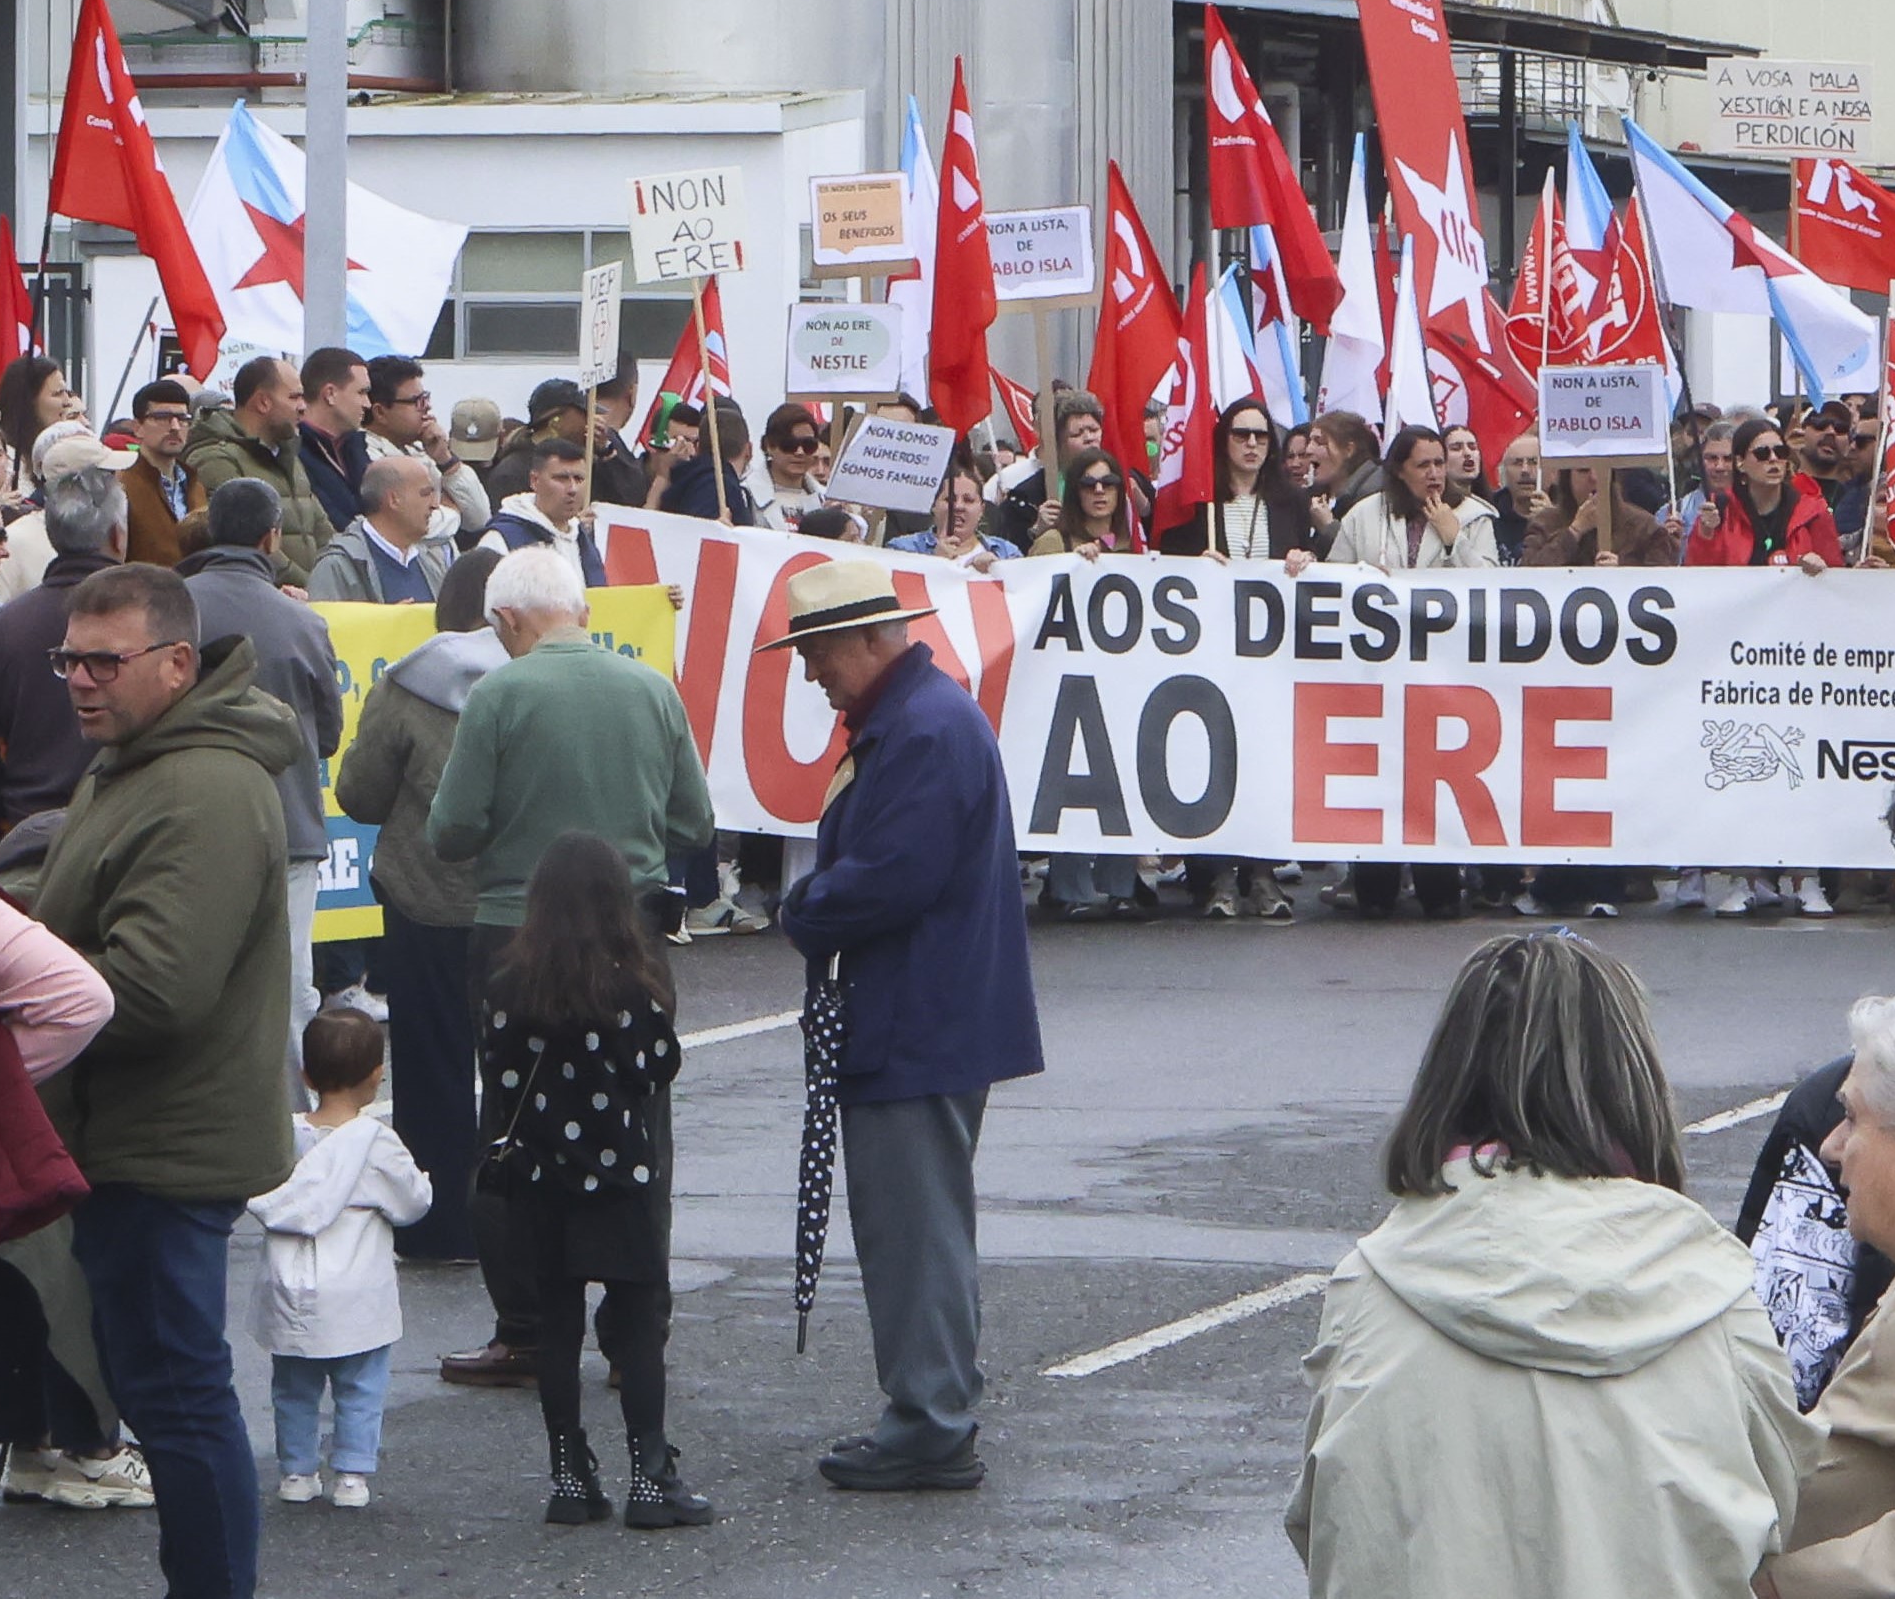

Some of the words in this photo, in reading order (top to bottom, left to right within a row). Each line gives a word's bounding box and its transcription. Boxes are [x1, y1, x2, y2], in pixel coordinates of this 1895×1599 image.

[1716, 67, 1733, 86] A
[1746, 68, 1793, 88] VOSA
[1809, 72, 1859, 89] MALA
[1799, 98, 1809, 116] E
[1814, 100, 1828, 116] A
[1832, 100, 1872, 117] NOSA
[1736, 122, 1855, 149] PERDICIÓN
[822, 212, 838, 224] OS
[842, 210, 868, 222] SEUS
[672, 217, 714, 242] AO
[839, 225, 895, 240] BENEFICIOS
[986, 222, 1014, 236] NON
[1018, 221, 1029, 233] A
[1016, 239, 1033, 252] DE
[991, 260, 1035, 277] ABLO
[1038, 257, 1073, 273] ISLA
[805, 320, 830, 332] NON
[833, 320, 850, 332] AO
[852, 319, 873, 332] ERE
[831, 336, 845, 347] DE
[810, 354, 869, 370] NESTLE
[1552, 376, 1585, 390] NON
[1587, 376, 1599, 389] A
[1585, 396, 1602, 409] DE
[1546, 416, 1603, 433] PABLO
[1606, 416, 1642, 431] ISLA
[866, 425, 895, 440] NON
[896, 428, 939, 447] SOMOS
[840, 463, 886, 480] SOMOS
[886, 471, 939, 489] FAMILIAS
[1033, 573, 1201, 656] AOS
[1234, 578, 1678, 667] DESPIDOS
[1730, 640, 1806, 666] Comité
[1813, 641, 1838, 667] de
[604, 524, 1016, 825] NON
[1701, 679, 1780, 705] Fábrica
[1788, 680, 1814, 706] de
[1027, 673, 1238, 839] AO
[1292, 682, 1614, 848] ERE
